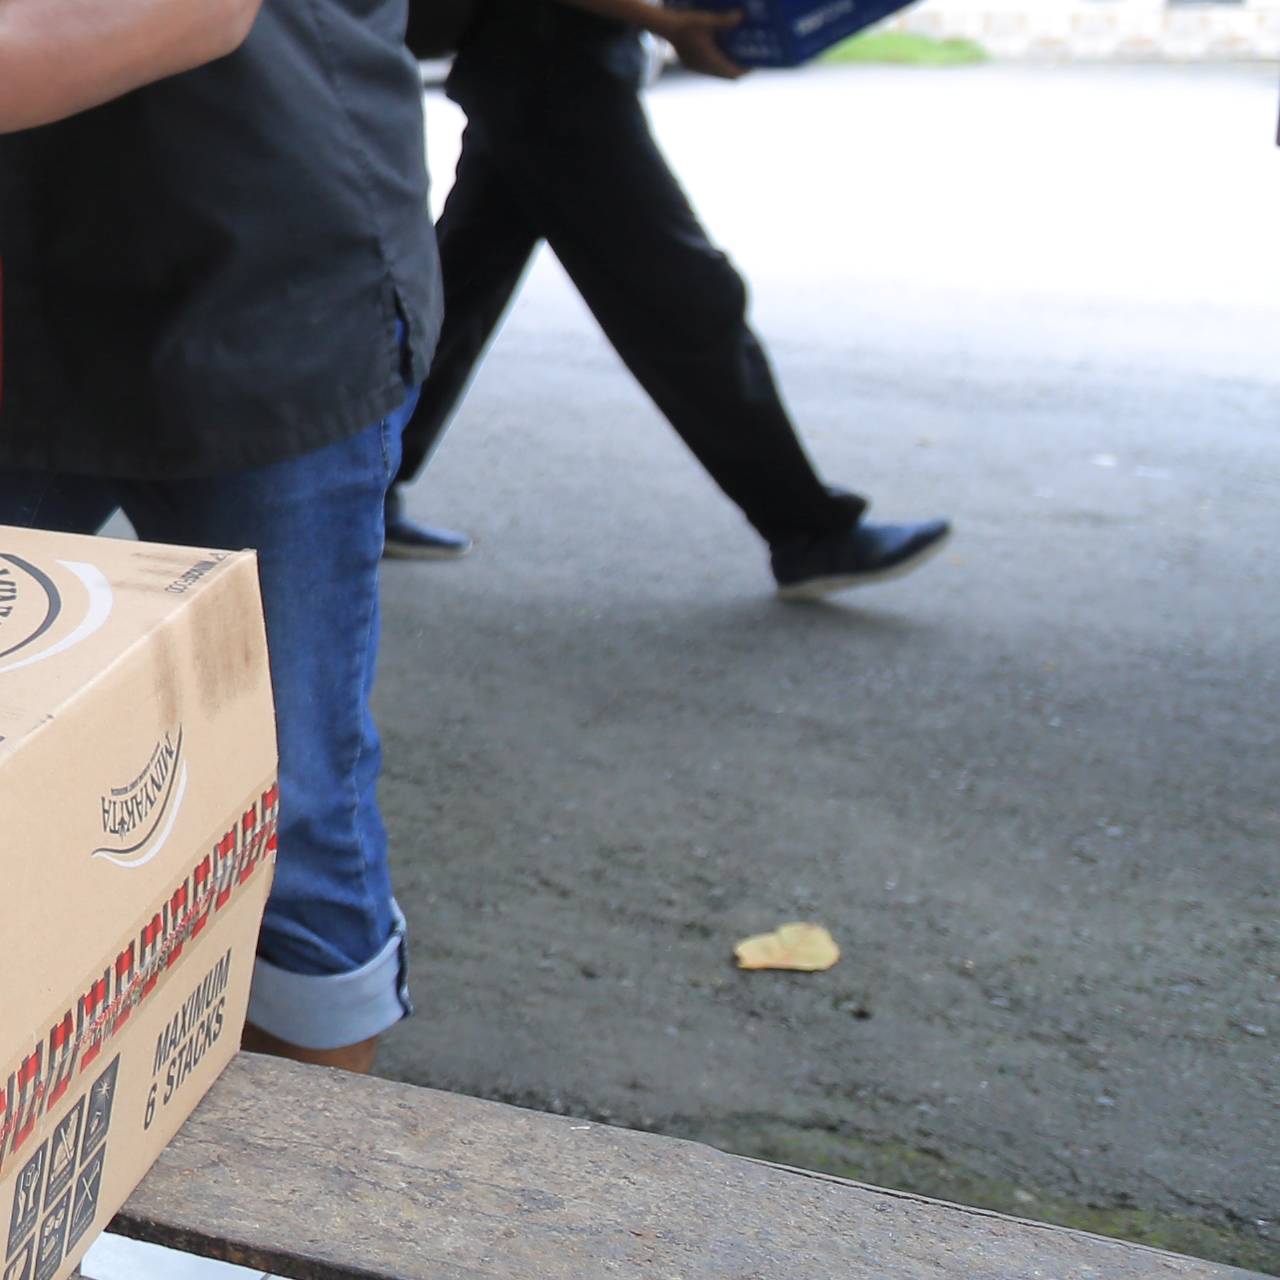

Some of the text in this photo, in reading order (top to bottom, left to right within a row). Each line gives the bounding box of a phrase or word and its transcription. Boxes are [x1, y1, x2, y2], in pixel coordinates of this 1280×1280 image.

[144, 1086, 157, 1131] 6
[163, 997, 226, 1106] STACKS
[153, 948, 231, 1077] MAXIMUM
